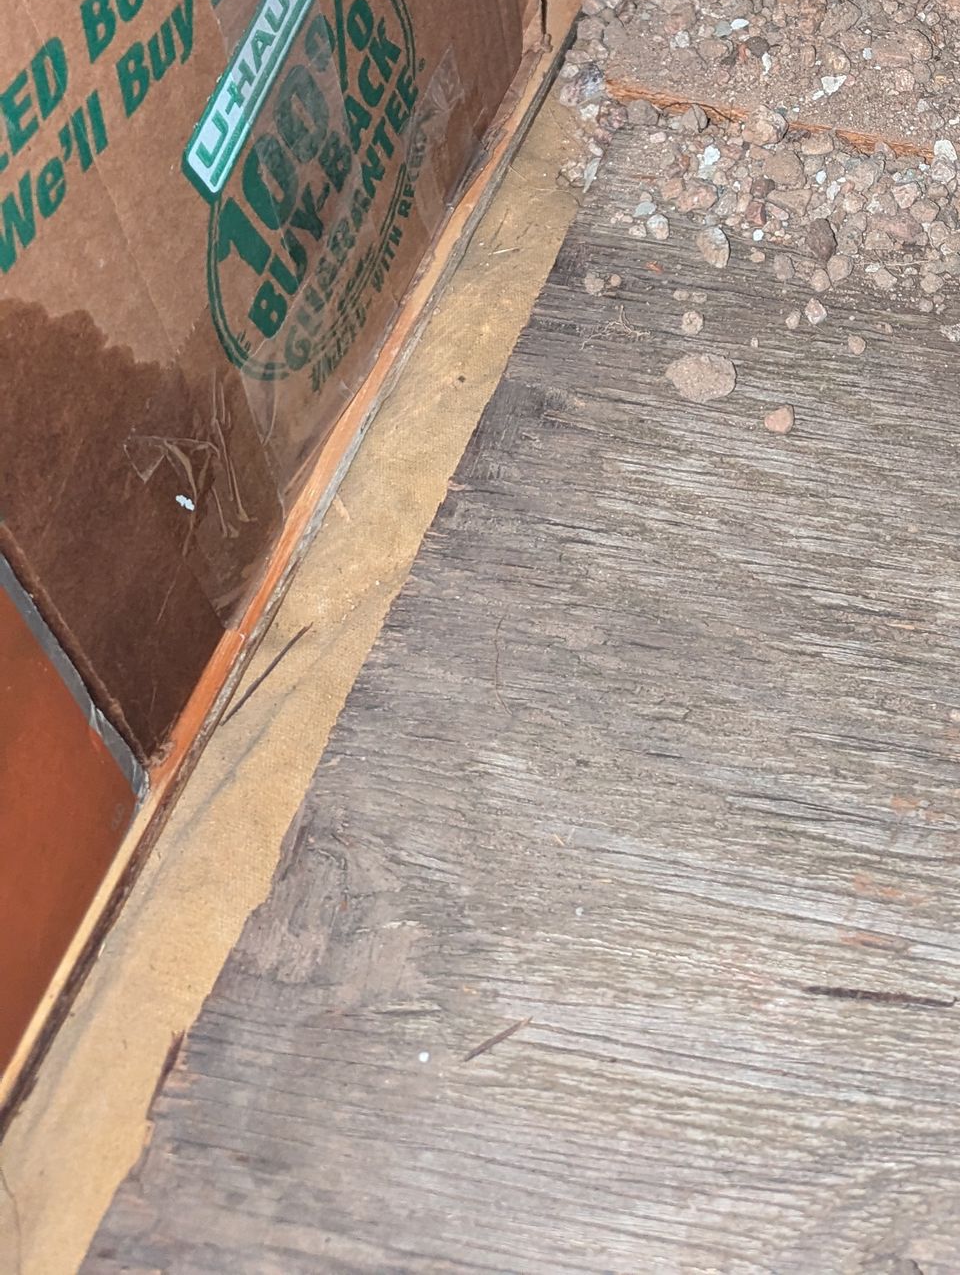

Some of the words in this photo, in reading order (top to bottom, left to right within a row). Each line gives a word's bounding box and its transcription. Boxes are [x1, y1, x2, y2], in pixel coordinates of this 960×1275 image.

[0, 35, 69, 173] ED
[0, 90, 109, 275] We'll
[248, 18, 402, 340] BUY-BACK
